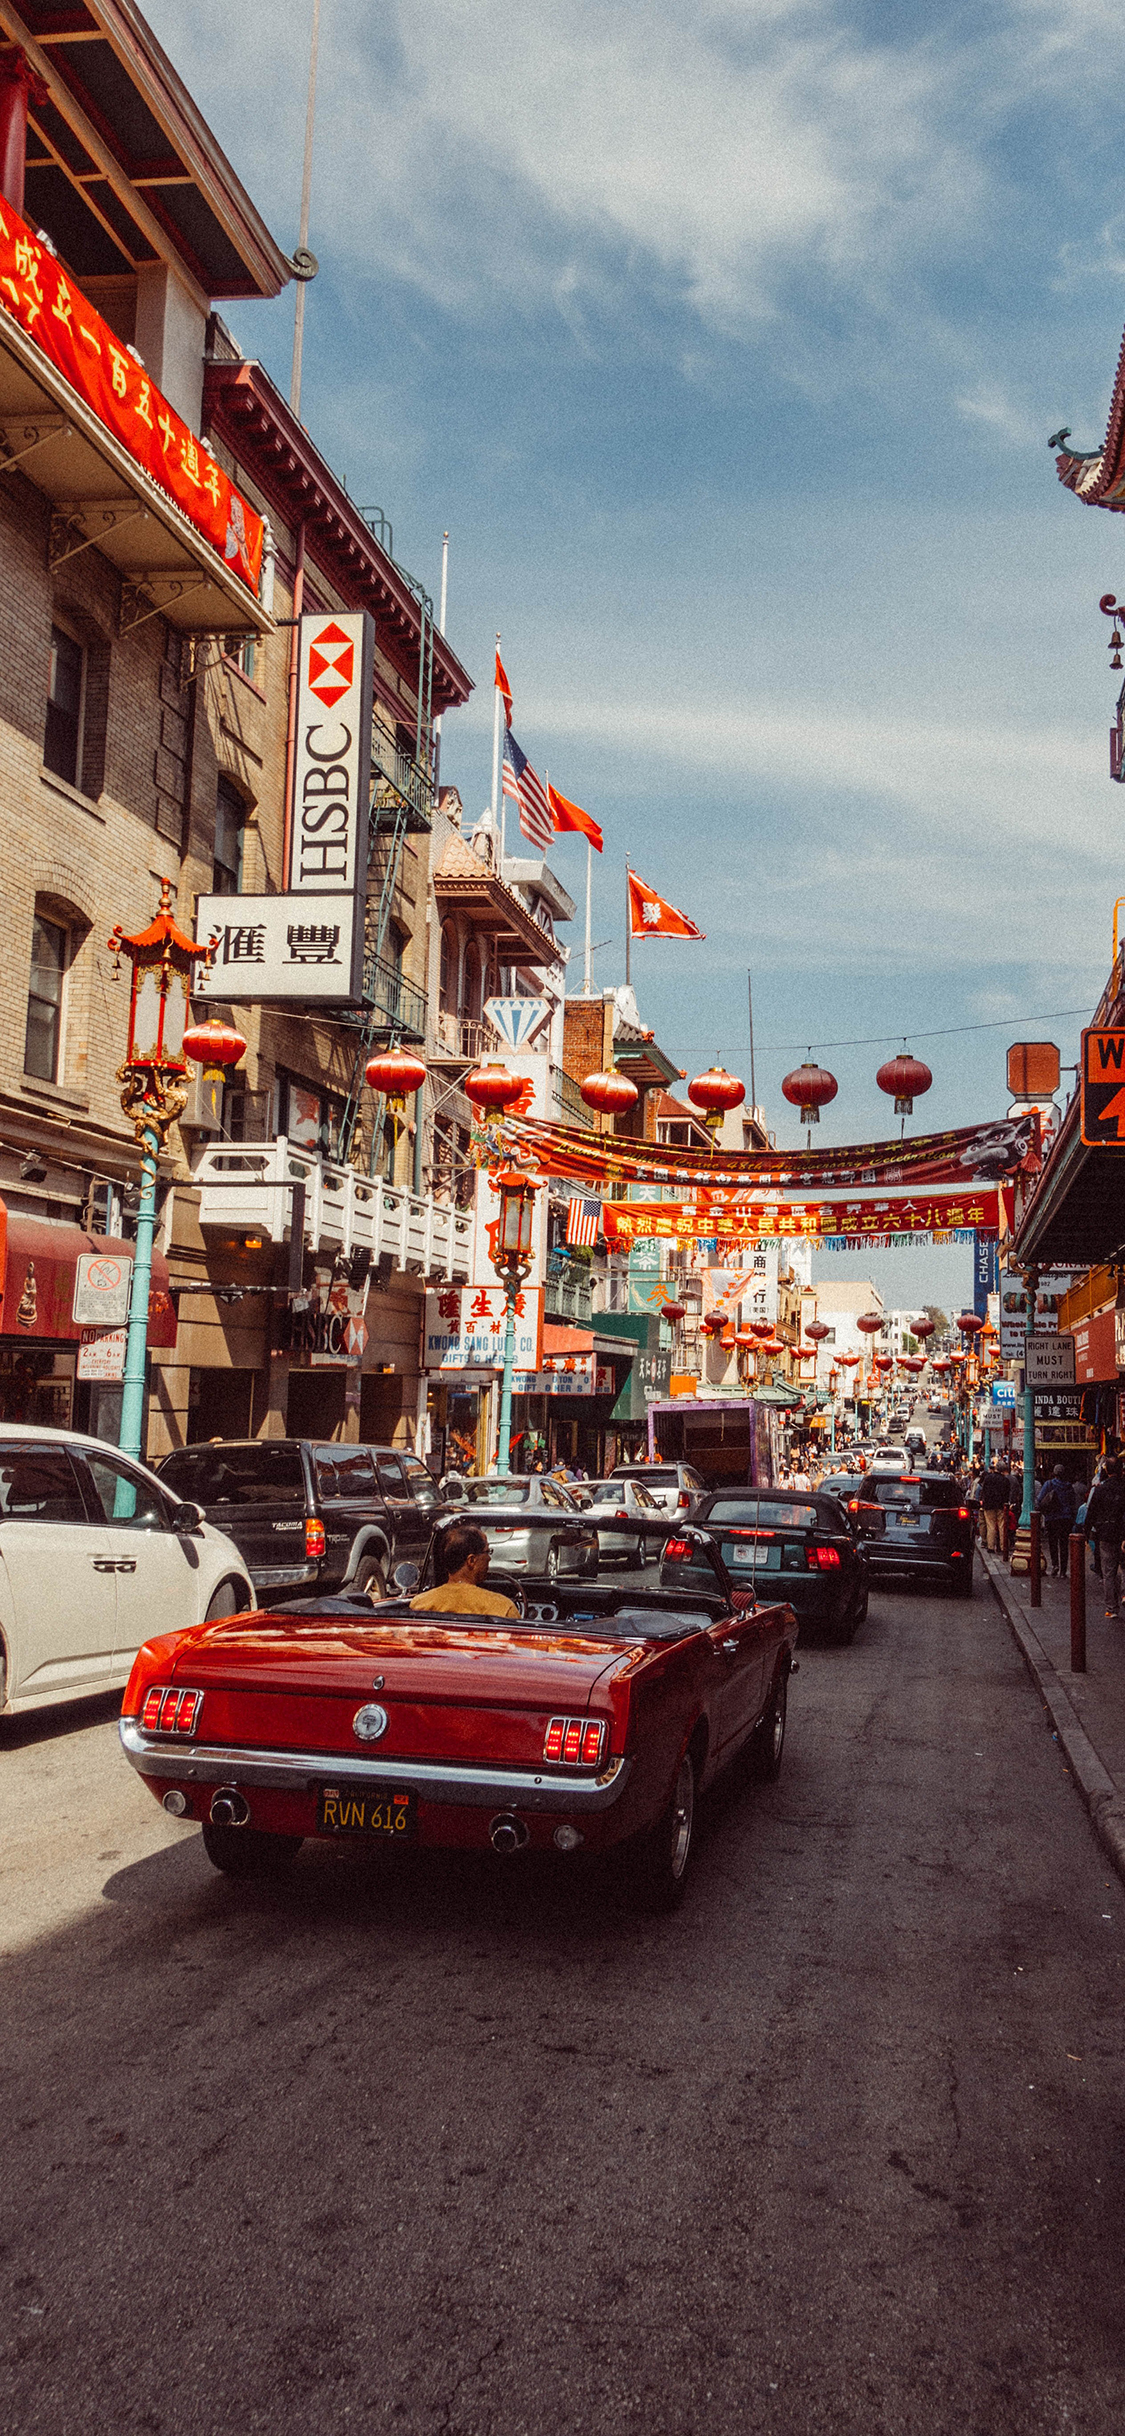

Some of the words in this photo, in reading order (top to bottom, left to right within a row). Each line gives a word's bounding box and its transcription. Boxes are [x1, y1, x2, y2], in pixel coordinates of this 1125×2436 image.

[0, 211, 221, 508] 成立一百五十週年
[299, 722, 353, 882] HSBC
[673, 1158, 720, 1170] Crane
[726, 1160, 764, 1172] 48th
[768, 1157, 863, 1172] Anniversary
[868, 1150, 957, 1167] Celebration
[615, 1206, 986, 1236] 熱烈慶祝中華人民共和國成立六十八週年
[979, 1239, 989, 1283] CHASE
[82, 1330, 96, 1343] NO
[97, 1333, 124, 1343] PARKING
[428, 1335, 460, 1351] KWONG
[464, 1336, 489, 1352] SANG
[492, 1337, 516, 1352] LUG
[520, 1337, 535, 1353] CO.
[1028, 1342, 1049, 1351] RIGHT
[1052, 1342, 1072, 1351] LANE
[442, 1353, 469, 1363] GIFTS
[485, 1354, 518, 1364] HERS
[1036, 1355, 1064, 1366] MUST
[511, 1375, 537, 1384] KWONG
[1028, 1370, 1048, 1379] TURN
[1051, 1370, 1074, 1380] RIGHT
[518, 1384, 537, 1392] GIFT
[271, 1521, 303, 1529] TACOMA
[323, 1800, 365, 1827] RVN
[371, 1803, 407, 1831] 616
